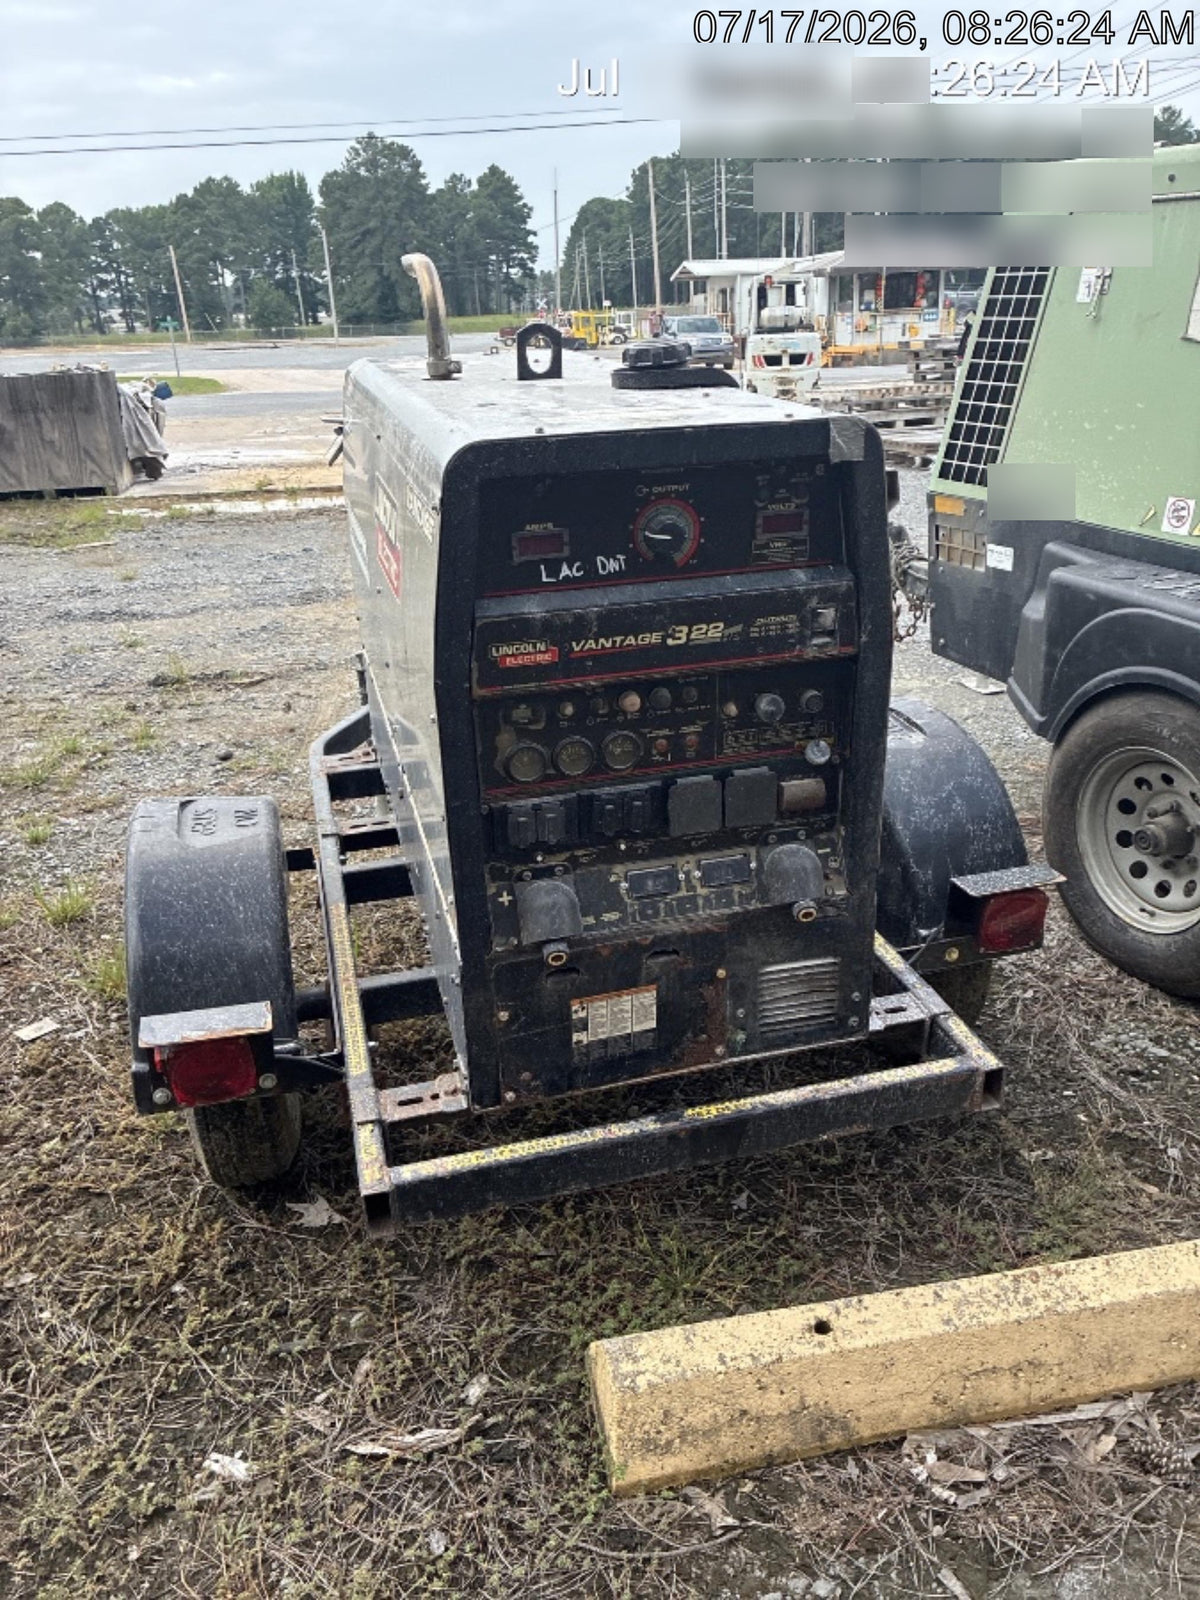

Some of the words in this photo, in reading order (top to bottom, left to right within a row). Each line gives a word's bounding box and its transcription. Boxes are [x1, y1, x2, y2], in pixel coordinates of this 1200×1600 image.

[652, 483, 690, 493] OUTPUT
[525, 522, 554, 531] AMPS
[540, 559, 585, 583] LAC
[570, 632, 664, 653] VANTAGE
[666, 621, 725, 647] 322
[491, 641, 547, 657] LINCOLN
[505, 652, 553, 665] ELECTRIC
